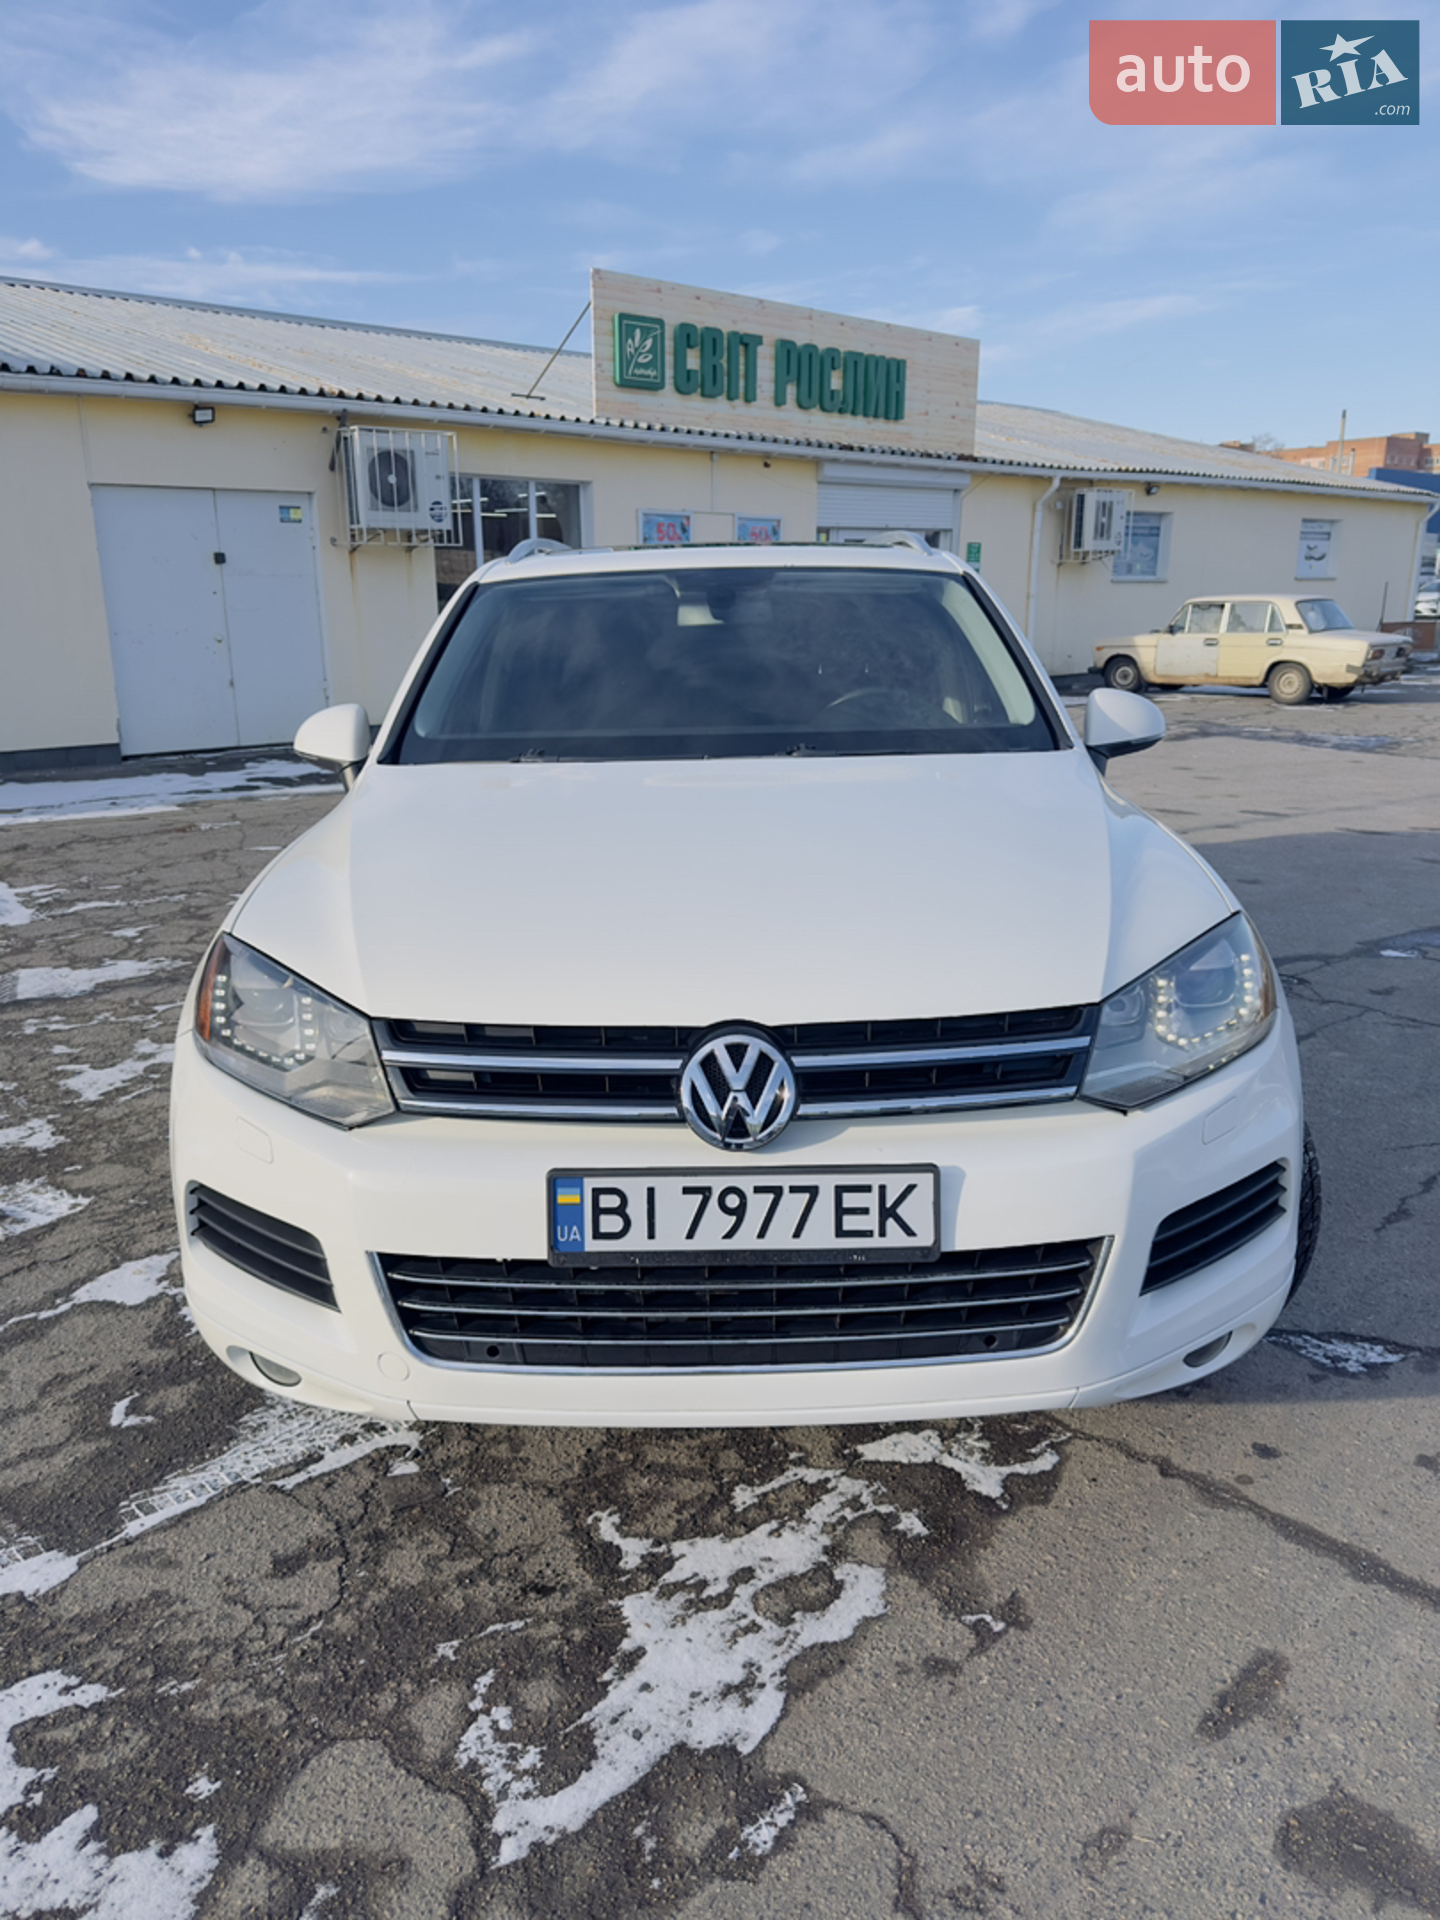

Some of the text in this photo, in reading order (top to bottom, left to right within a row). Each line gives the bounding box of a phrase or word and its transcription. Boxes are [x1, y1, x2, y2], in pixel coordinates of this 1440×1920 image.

[674, 322, 907, 421] СВІТ РОСЛИН
[557, 1225, 582, 1242] UA
[591, 1183, 918, 1240] BI 7977 EK
